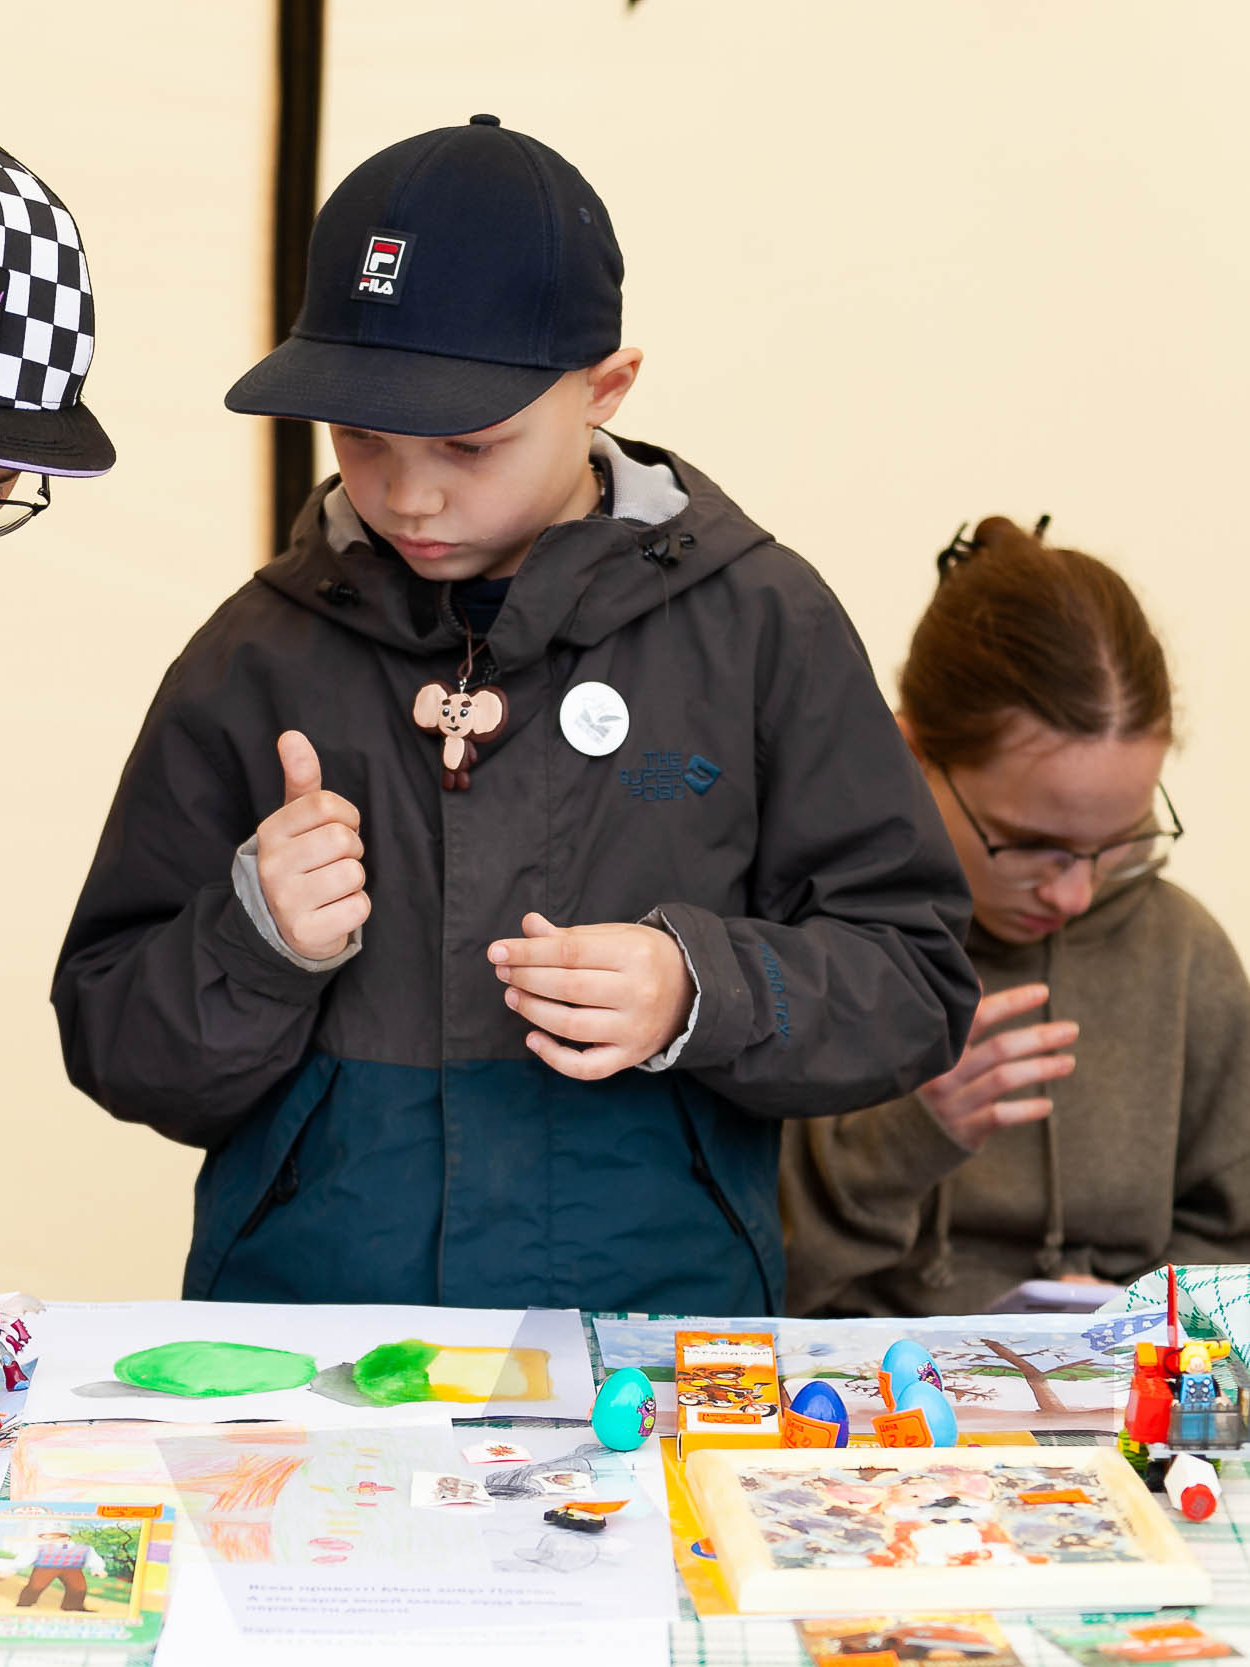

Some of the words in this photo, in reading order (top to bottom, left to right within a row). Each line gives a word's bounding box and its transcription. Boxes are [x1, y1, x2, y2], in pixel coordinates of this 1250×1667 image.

[358, 277, 394, 295] FILA
[642, 751, 682, 769] THE
[878, 1422, 899, 1433] Цена
